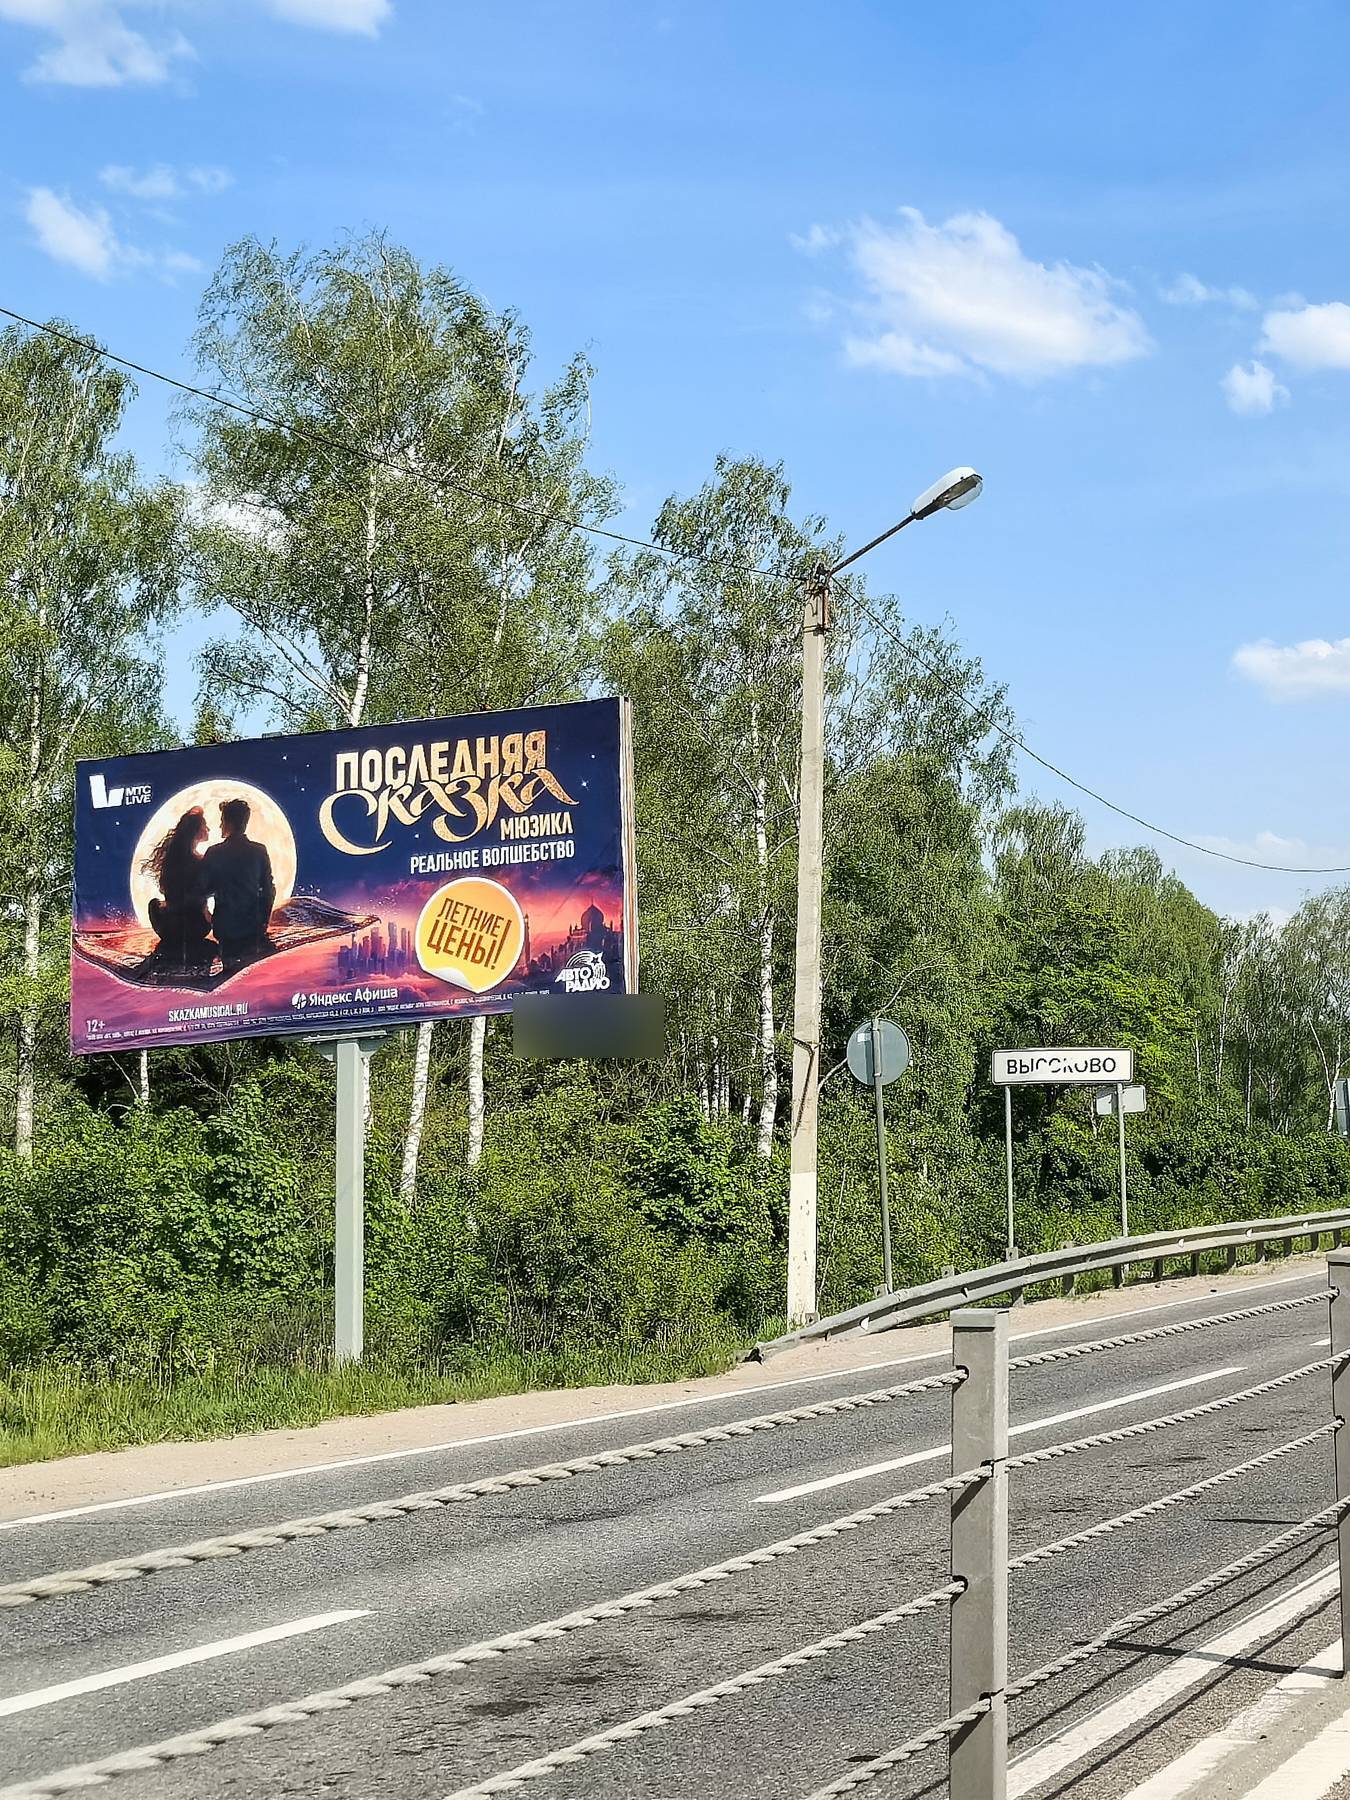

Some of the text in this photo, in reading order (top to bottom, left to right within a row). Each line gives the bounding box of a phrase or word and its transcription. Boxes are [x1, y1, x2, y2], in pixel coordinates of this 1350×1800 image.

[336, 730, 546, 791] ПОСЛЕДНЯЯ
[126, 794, 151, 805] LIVE
[501, 811, 573, 840] МЮЗИКЛ
[410, 840, 575, 874] РЕАЛЬНОЕ ВОЛШЕБСТВО
[437, 897, 505, 938] ЛЕТНИЕ
[426, 918, 513, 970] ЦЕНЫ!
[555, 966, 593, 983] АВТО
[565, 976, 611, 993] РАДИО
[309, 991, 353, 1006] Яндекс
[354, 987, 398, 1003] Афиша
[168, 1002, 249, 1022] SKAZKAMUSICAL.RU
[86, 1019, 106, 1033] 12+
